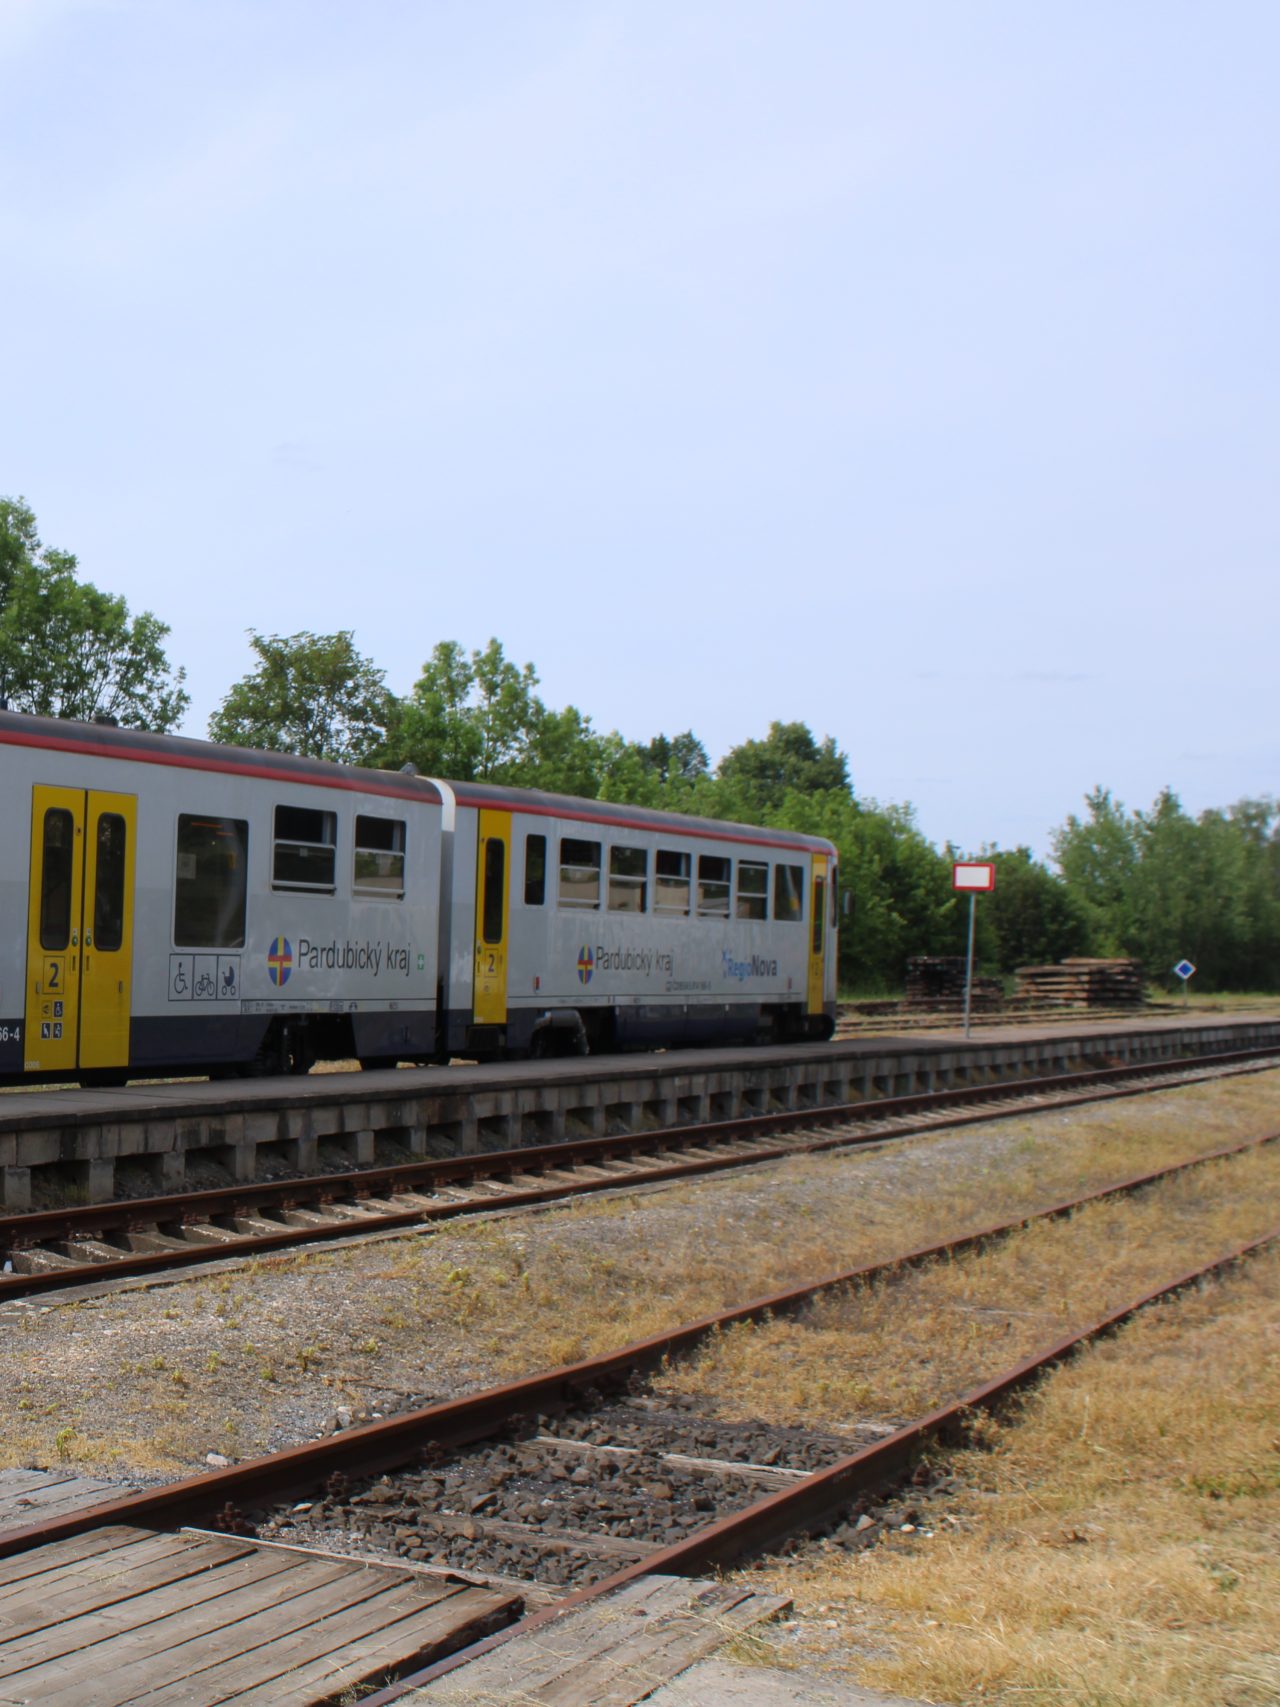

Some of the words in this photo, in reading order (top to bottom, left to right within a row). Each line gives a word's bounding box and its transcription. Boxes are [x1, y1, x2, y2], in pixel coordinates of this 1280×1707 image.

[298, 939, 383, 977] Pardubický
[386, 940, 411, 977] kraj
[488, 954, 495, 972] 2
[595, 945, 653, 977] Pardubický
[655, 947, 673, 977] kraj
[727, 955, 778, 982] RegioNova
[48, 962, 59, 987] 2
